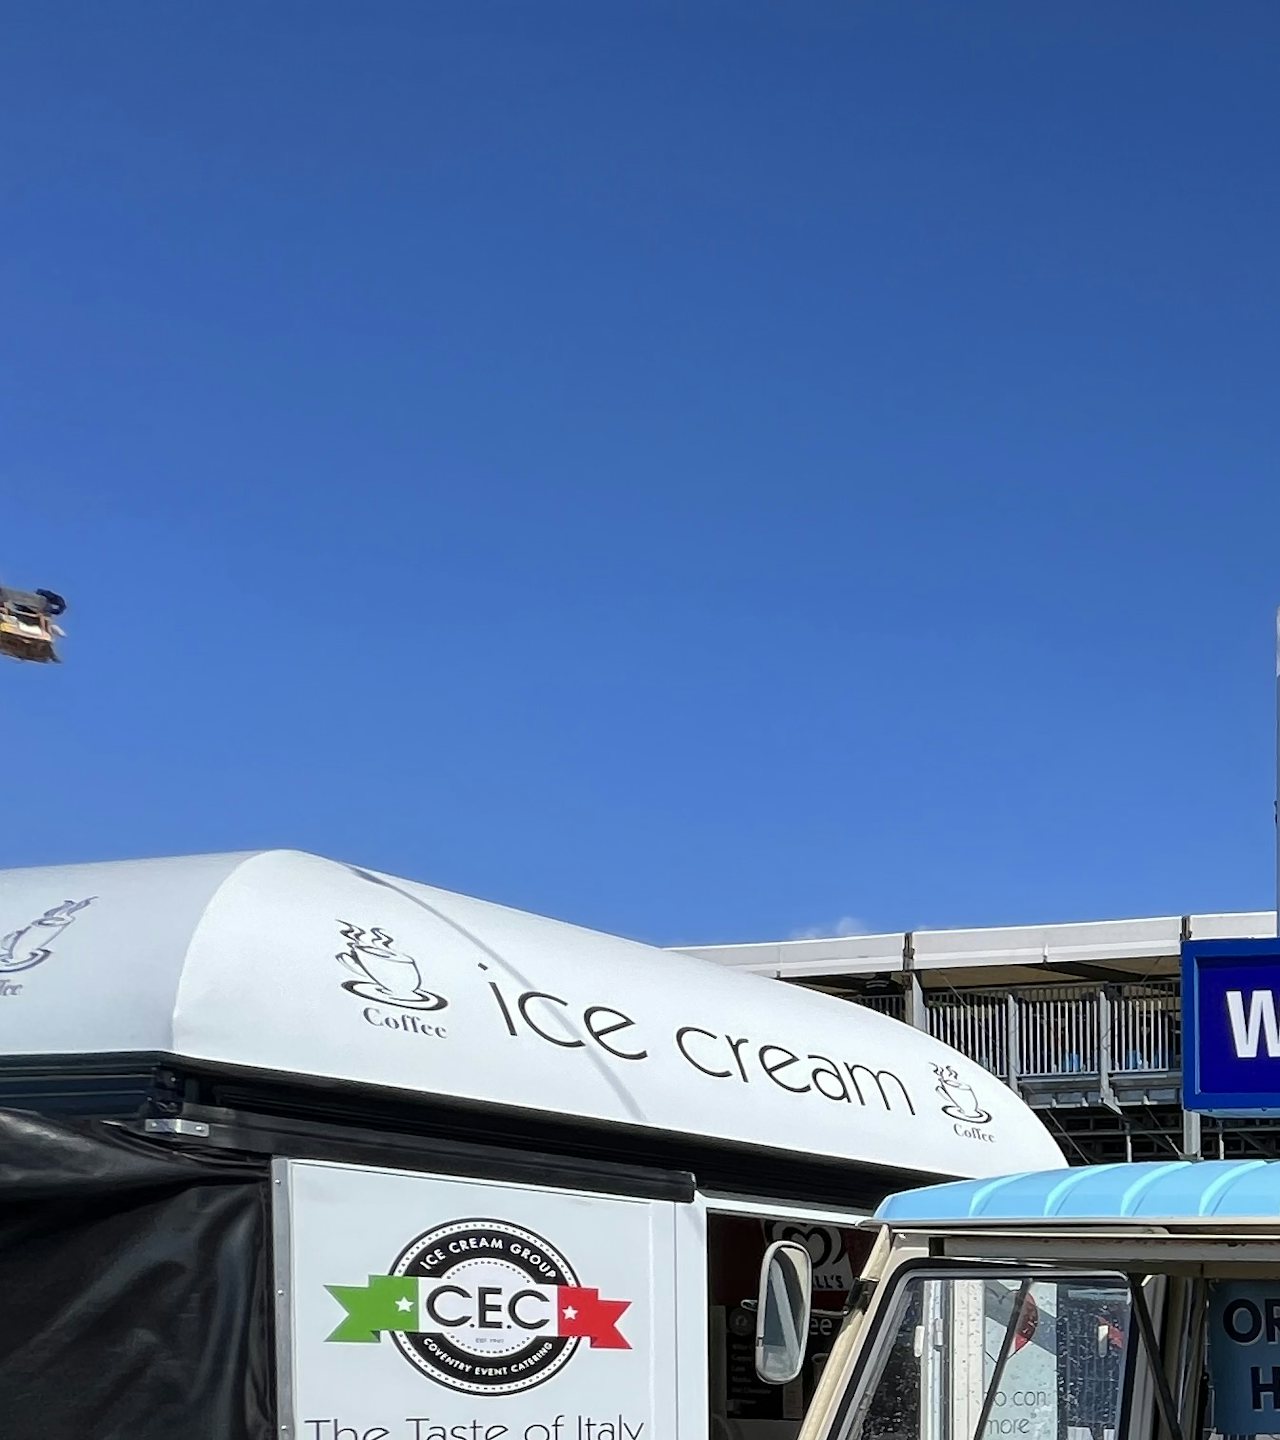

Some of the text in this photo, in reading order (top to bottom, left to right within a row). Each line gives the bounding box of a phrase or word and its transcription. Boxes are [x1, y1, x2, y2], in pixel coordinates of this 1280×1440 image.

[362, 1006, 449, 1040] Coffee
[477, 962, 916, 1117] ice cream
[953, 1123, 996, 1144] Coffee
[419, 1236, 557, 1279] ICE CREAM GROUP
[426, 1285, 551, 1330] C.E.C
[423, 1337, 554, 1376] COVENTRY EVENT CATERING
